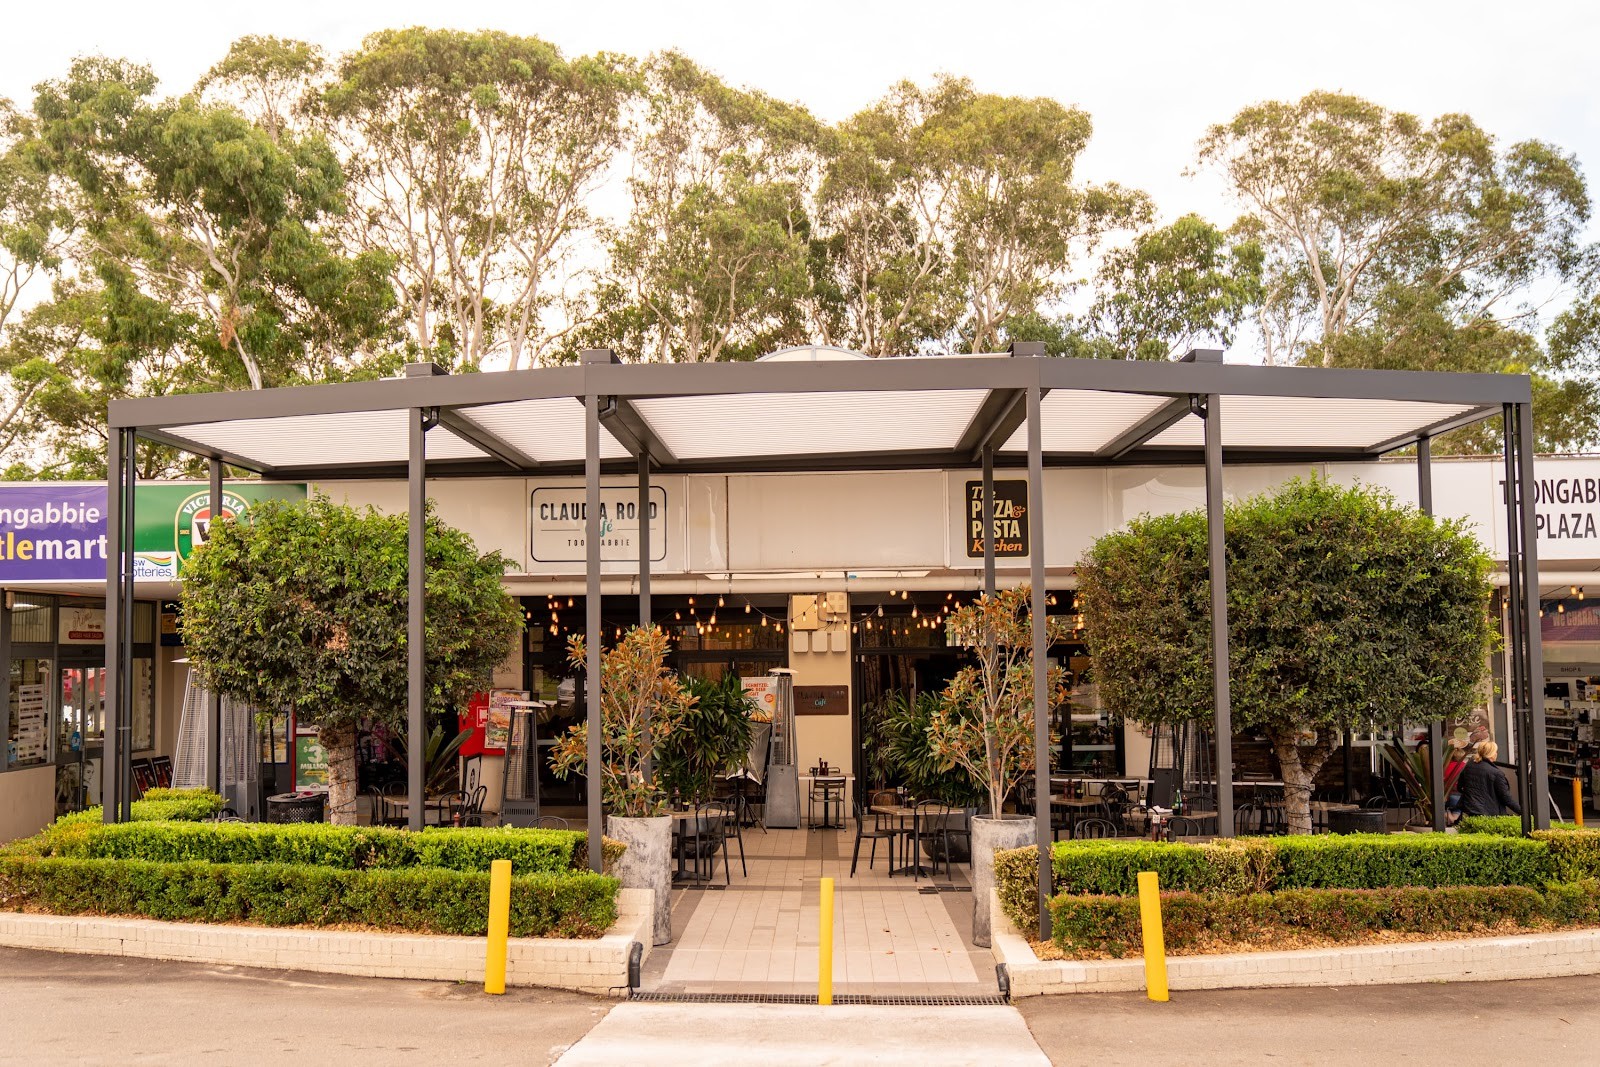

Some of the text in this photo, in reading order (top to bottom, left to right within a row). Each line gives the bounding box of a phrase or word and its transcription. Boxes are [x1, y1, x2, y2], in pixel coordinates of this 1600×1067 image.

[1498, 478, 1600, 505] TNGAB
[182, 495, 245, 515] VICTRIA
[540, 501, 658, 521] CLAUDA ROD
[971, 499, 1014, 519] PZA
[585, 519, 613, 537] fé
[971, 519, 1021, 539] PSTA
[1535, 512, 1598, 539] PLAZA
[567, 539, 630, 547] TOOABBIE
[971, 538, 1023, 552] Kchen
[300, 763, 329, 771] MILLION
